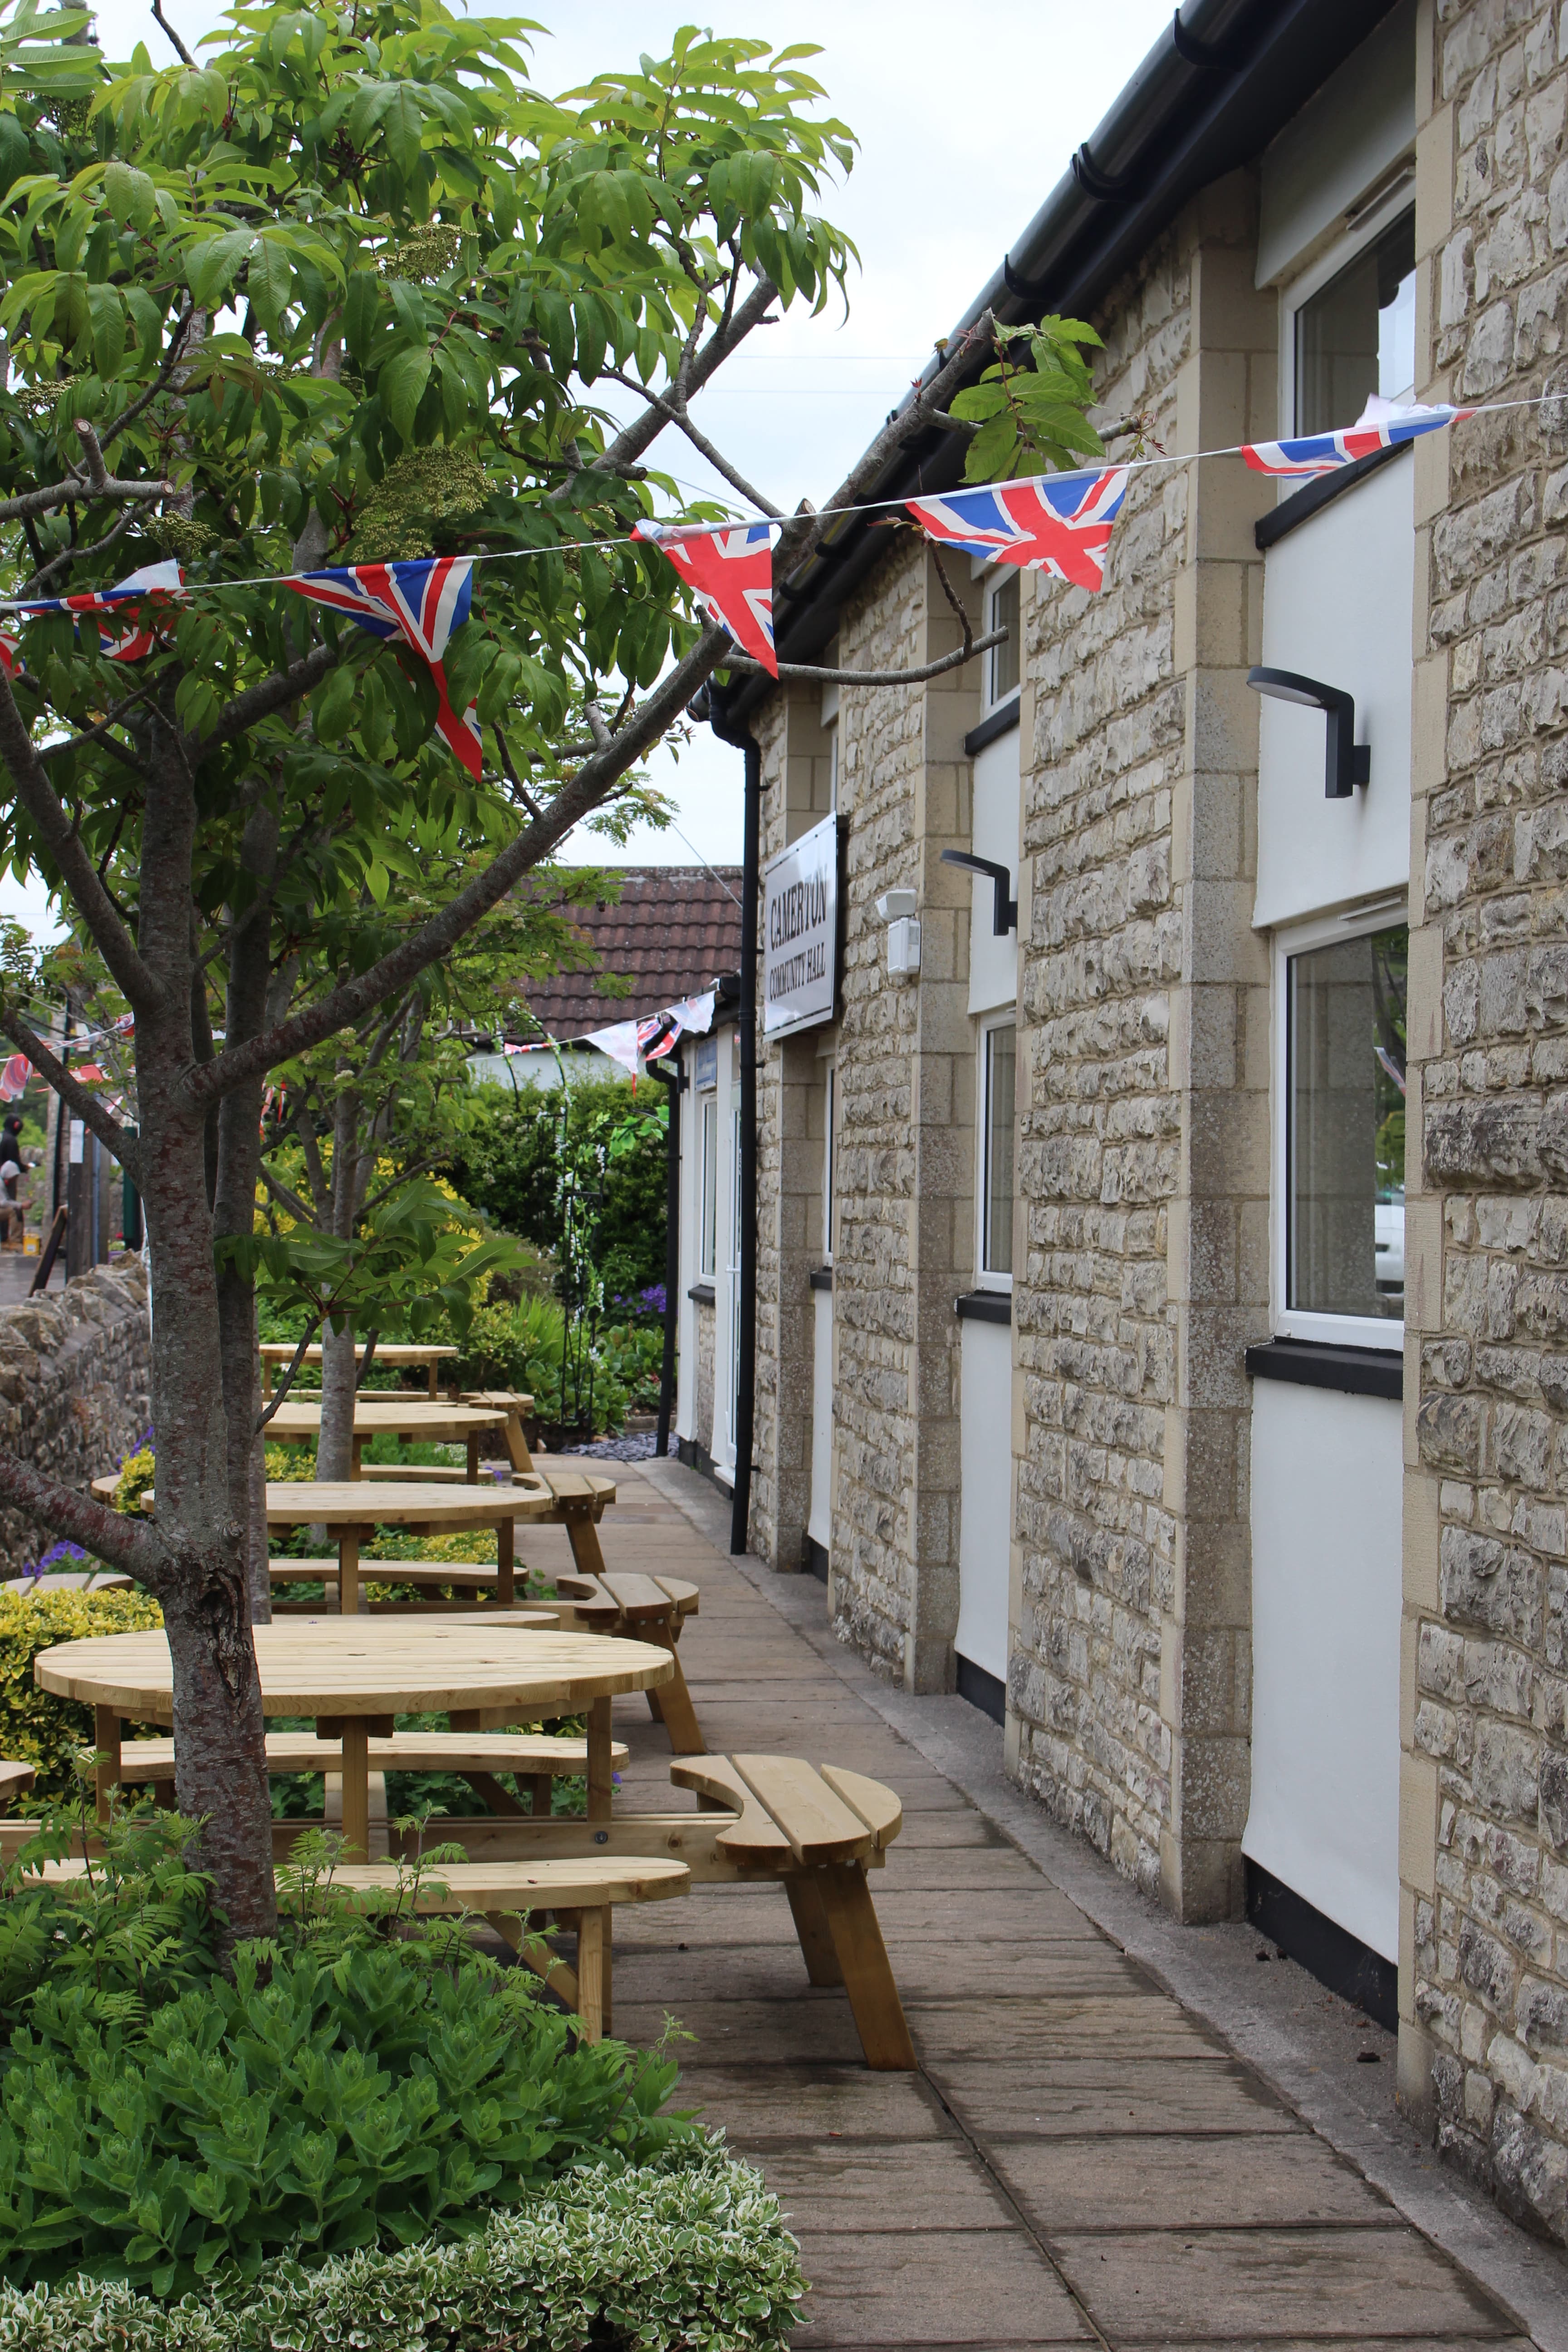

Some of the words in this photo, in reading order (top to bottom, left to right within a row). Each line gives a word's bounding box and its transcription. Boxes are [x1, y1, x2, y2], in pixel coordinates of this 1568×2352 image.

[771, 864, 827, 951] CAMERTON
[770, 952, 806, 1001] COMMUNITY
[807, 942, 825, 984] HALL
